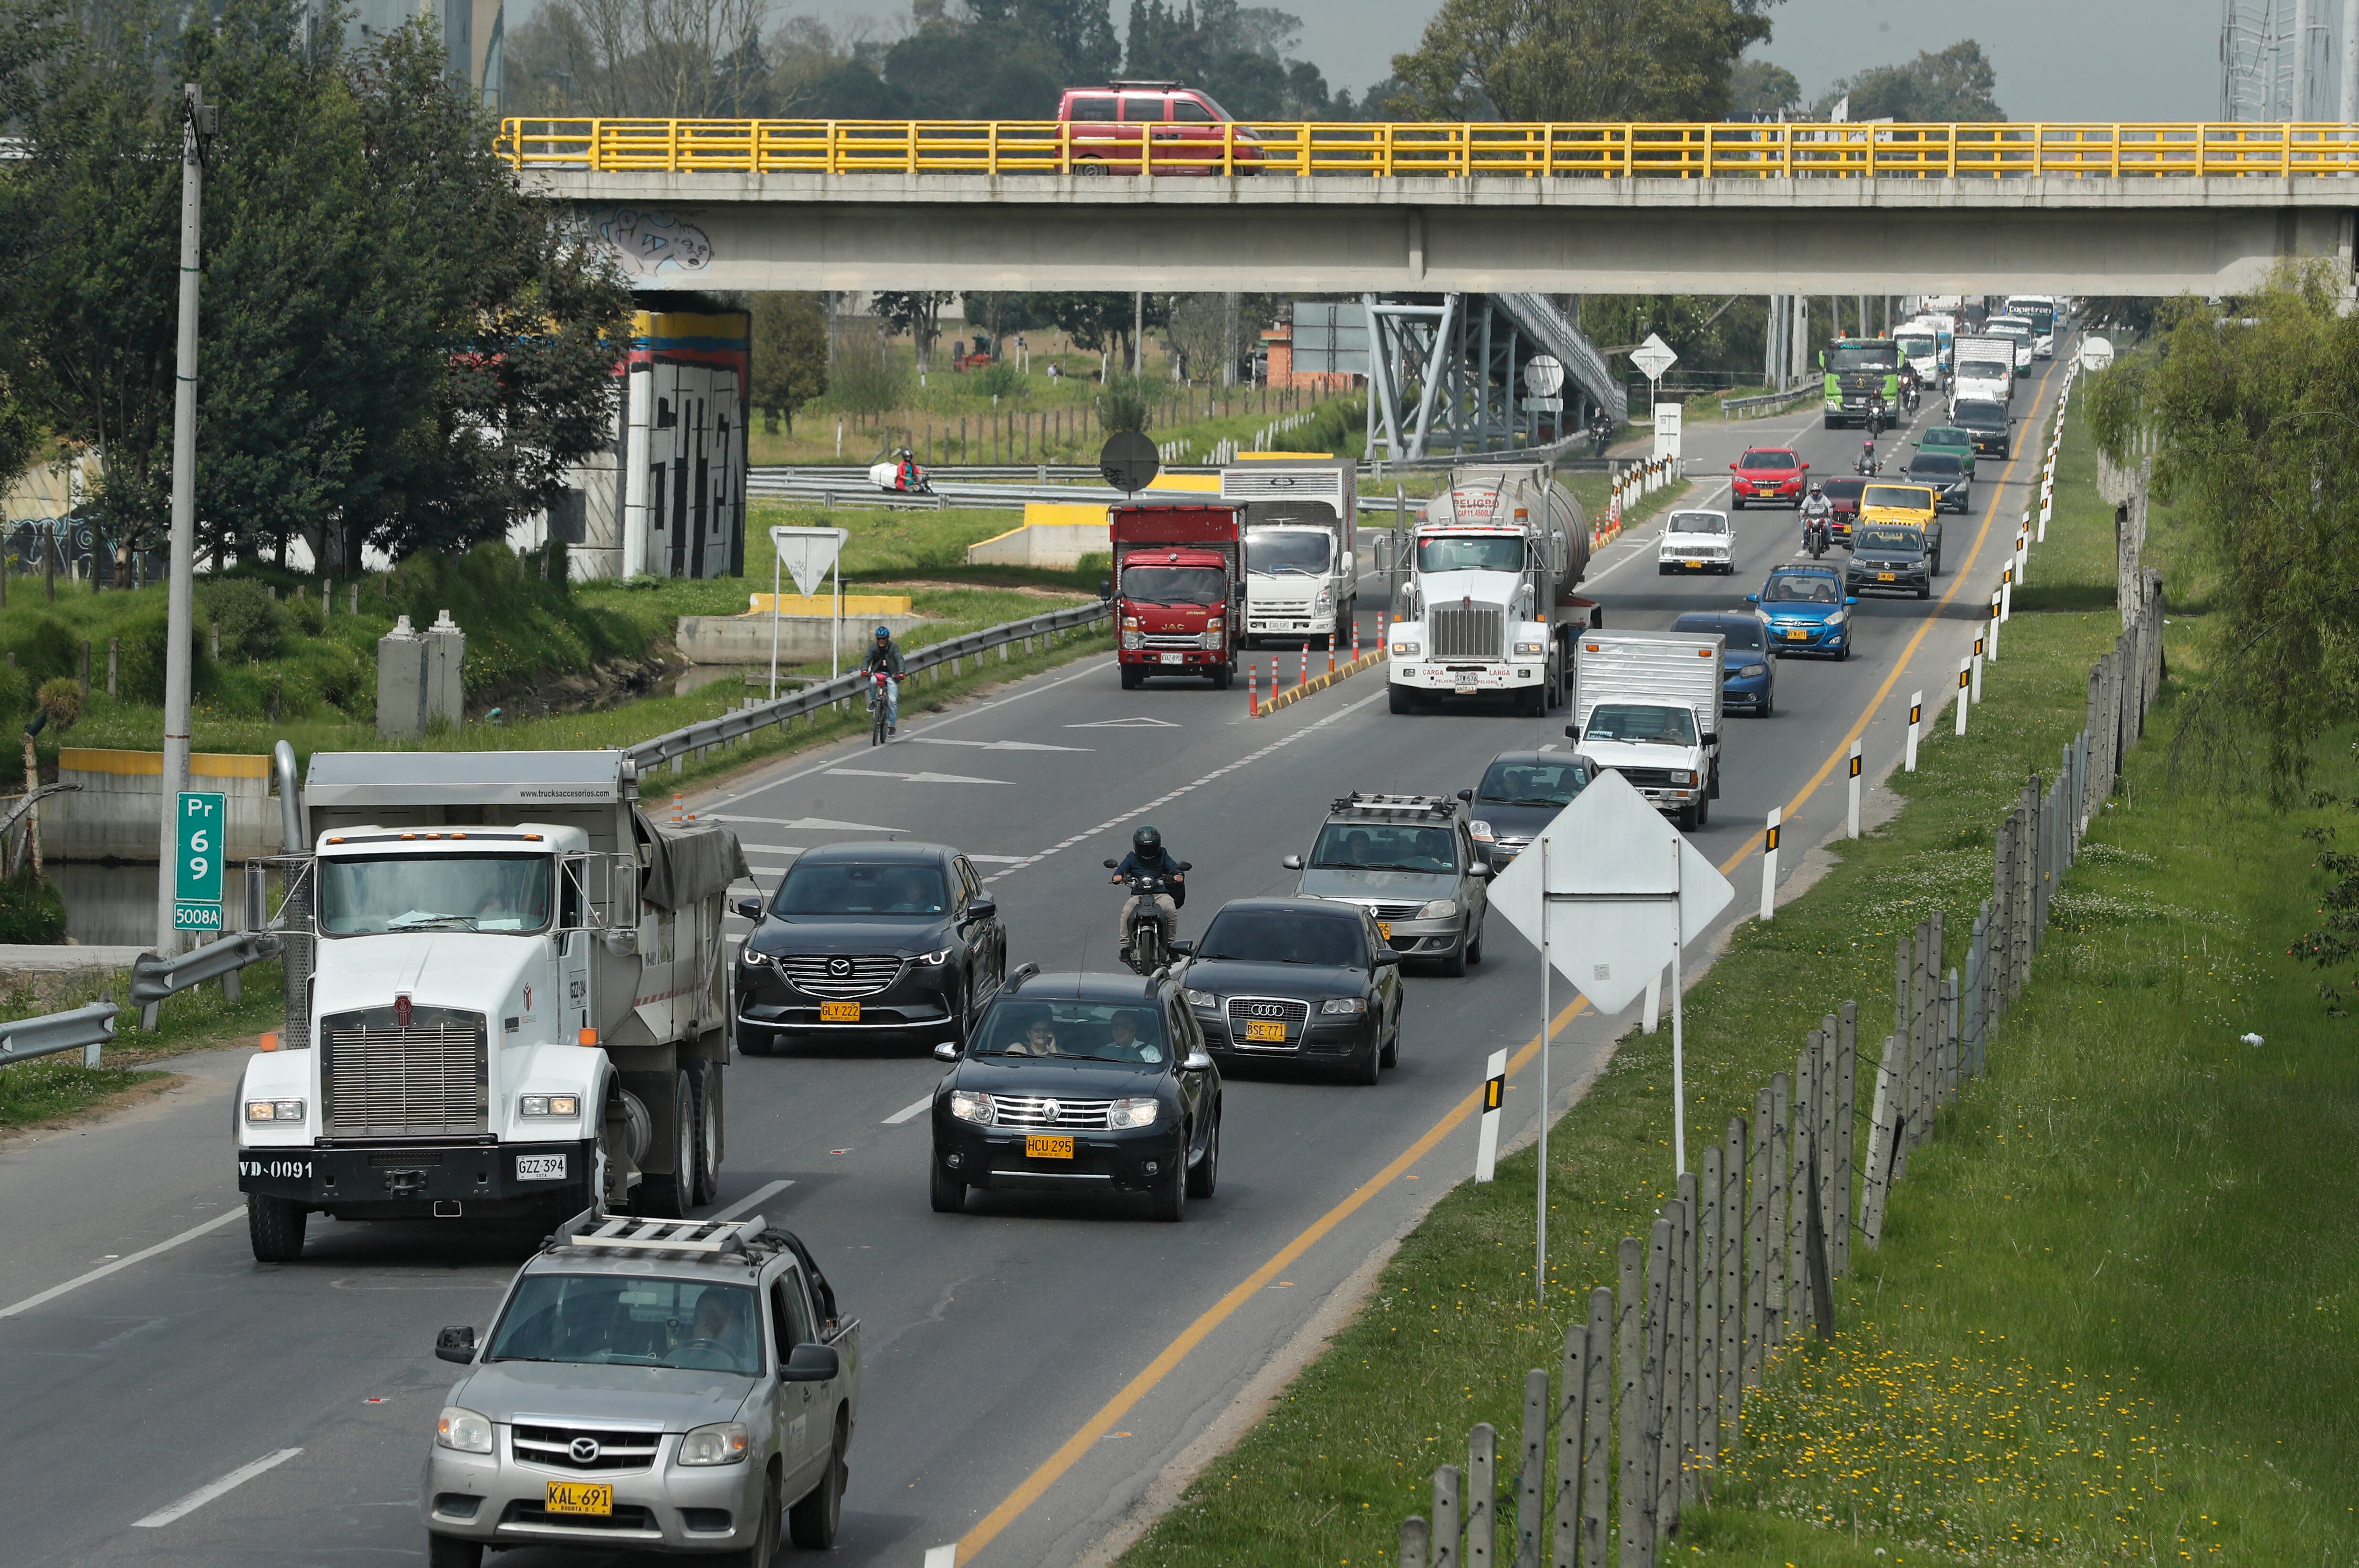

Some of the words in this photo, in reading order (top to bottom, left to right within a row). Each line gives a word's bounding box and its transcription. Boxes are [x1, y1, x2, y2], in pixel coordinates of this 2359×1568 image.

[1453, 499, 1499, 508] PELIGRO
[520, 789, 610, 798] www.trucksaccesorios.com
[188, 799, 213, 817] Pr
[177, 908, 219, 925] 5008A
